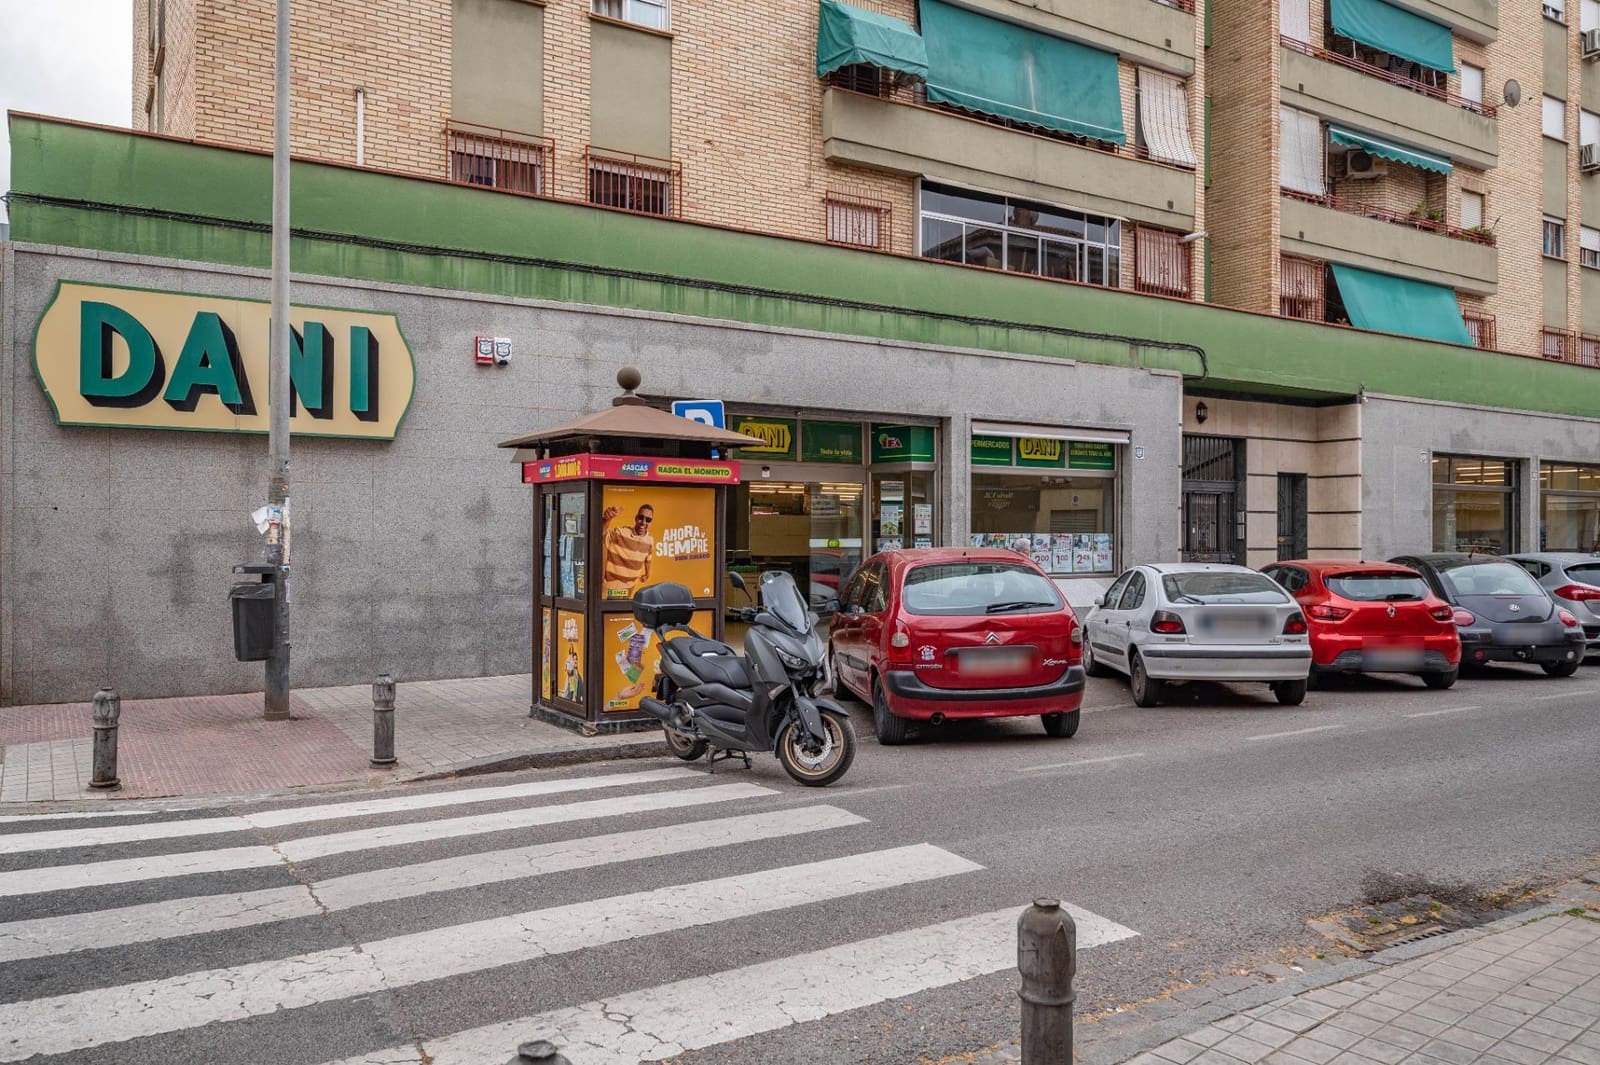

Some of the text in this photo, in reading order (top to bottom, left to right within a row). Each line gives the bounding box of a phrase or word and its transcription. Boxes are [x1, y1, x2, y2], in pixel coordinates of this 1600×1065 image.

[80, 301, 379, 421] DANI
[743, 425, 785, 448] DANI
[1025, 438, 1056, 456] DANI
[622, 463, 648, 472] RASCAS
[658, 466, 682, 474] RASCA
[693, 467, 730, 476] MOMENTO
[663, 525, 700, 542] AHORA
[656, 538, 708, 557] SIEMPRE
